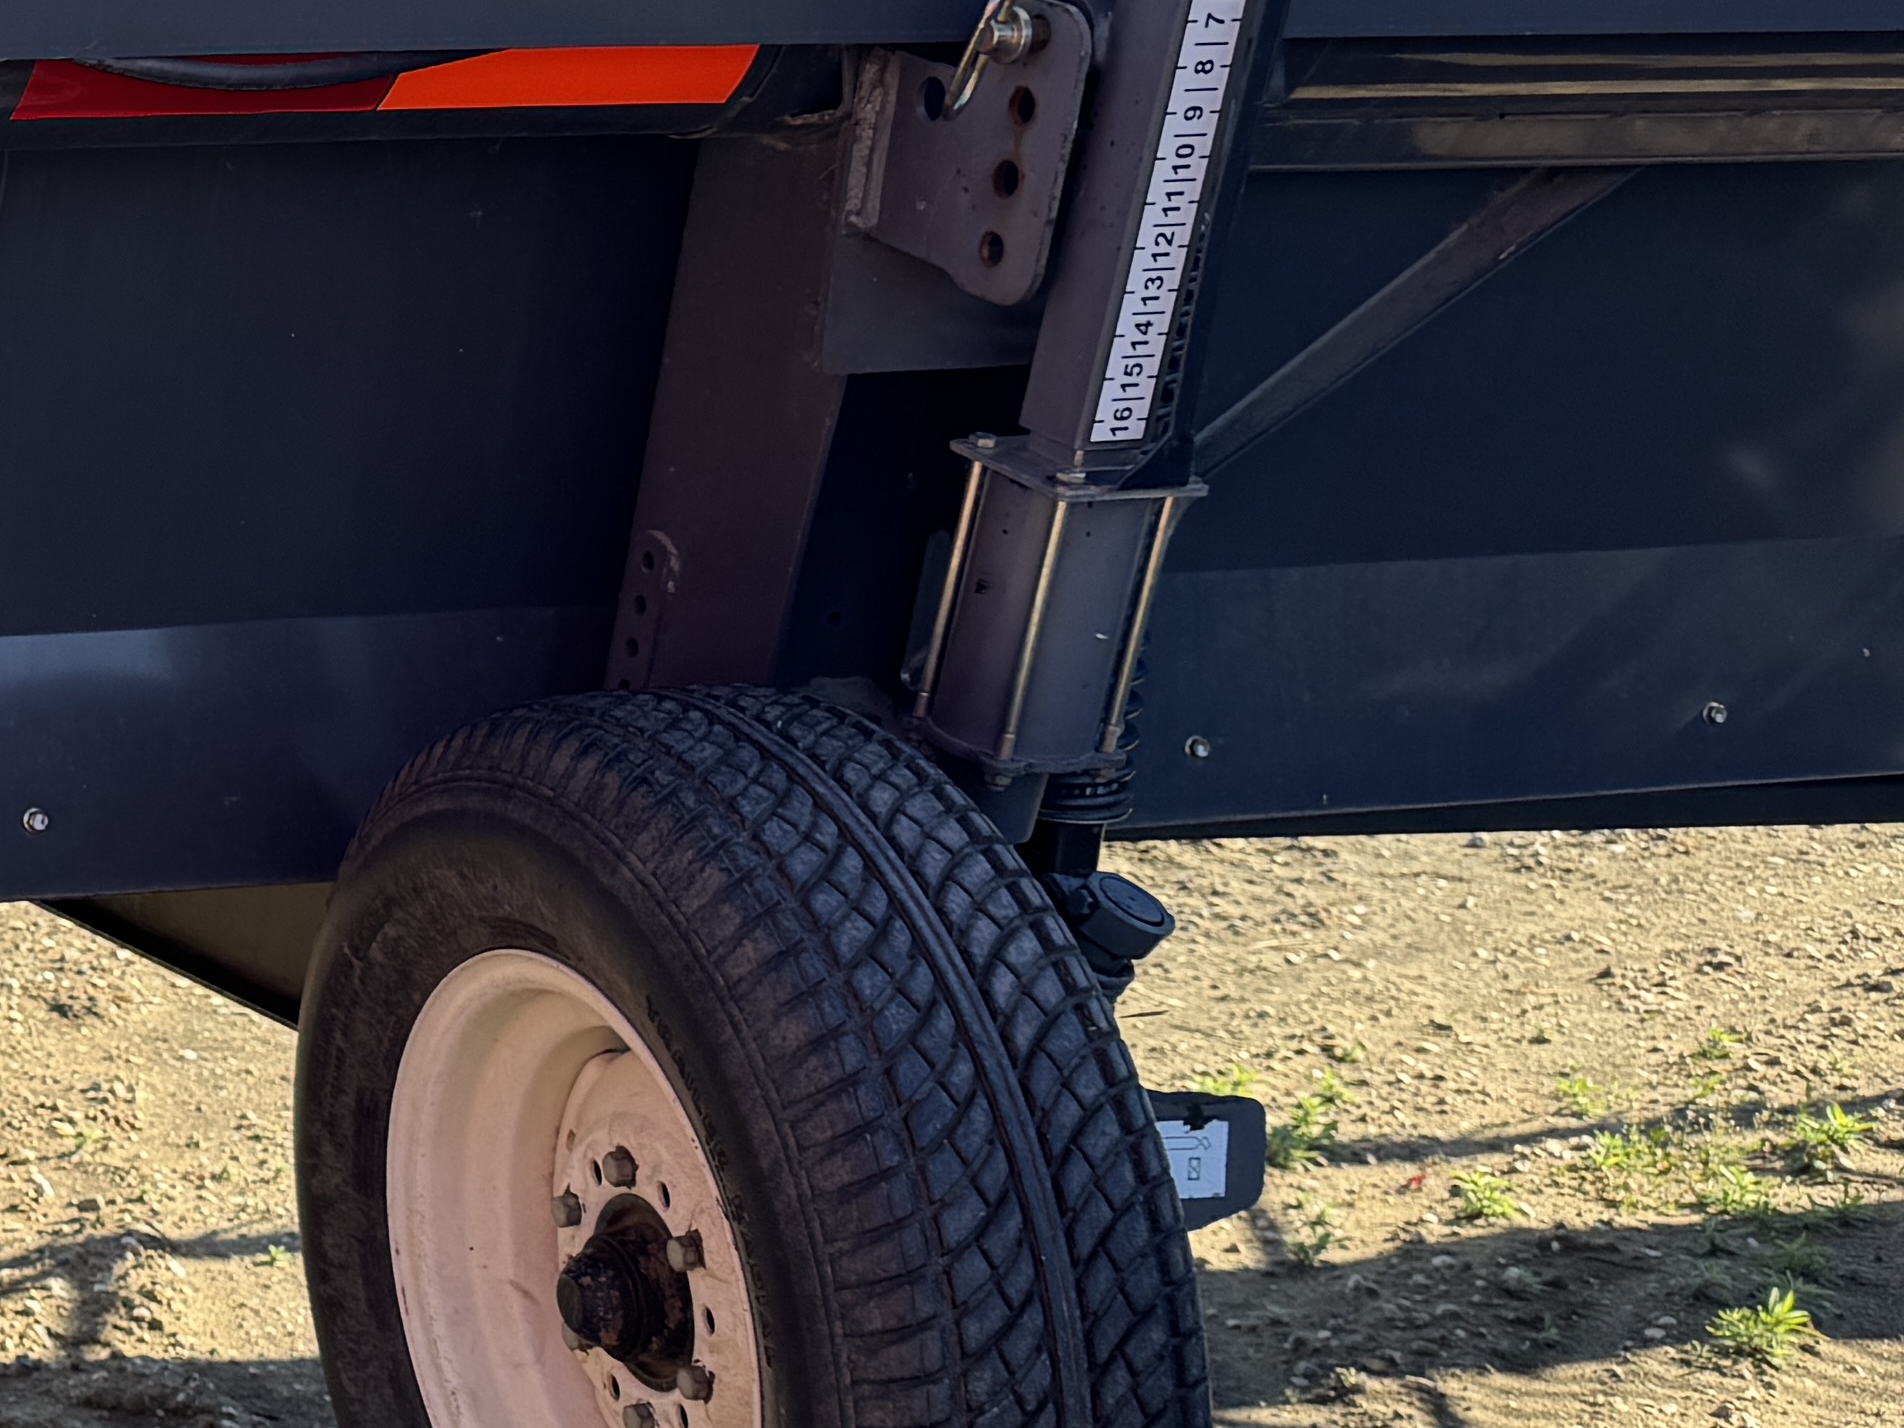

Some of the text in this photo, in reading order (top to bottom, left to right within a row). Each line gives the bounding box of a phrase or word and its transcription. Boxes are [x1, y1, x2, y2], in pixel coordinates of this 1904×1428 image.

[1205, 12, 1225, 28] 7
[1194, 59, 1214, 75] 8
[1183, 105, 1204, 121] 9
[1171, 143, 1195, 175] 10
[1161, 190, 1185, 217] 11
[1151, 231, 1175, 262] 12
[1141, 275, 1164, 306] 13
[1130, 320, 1154, 351] 14
[1120, 362, 1143, 393] 15
[1109, 406, 1133, 437] 16
